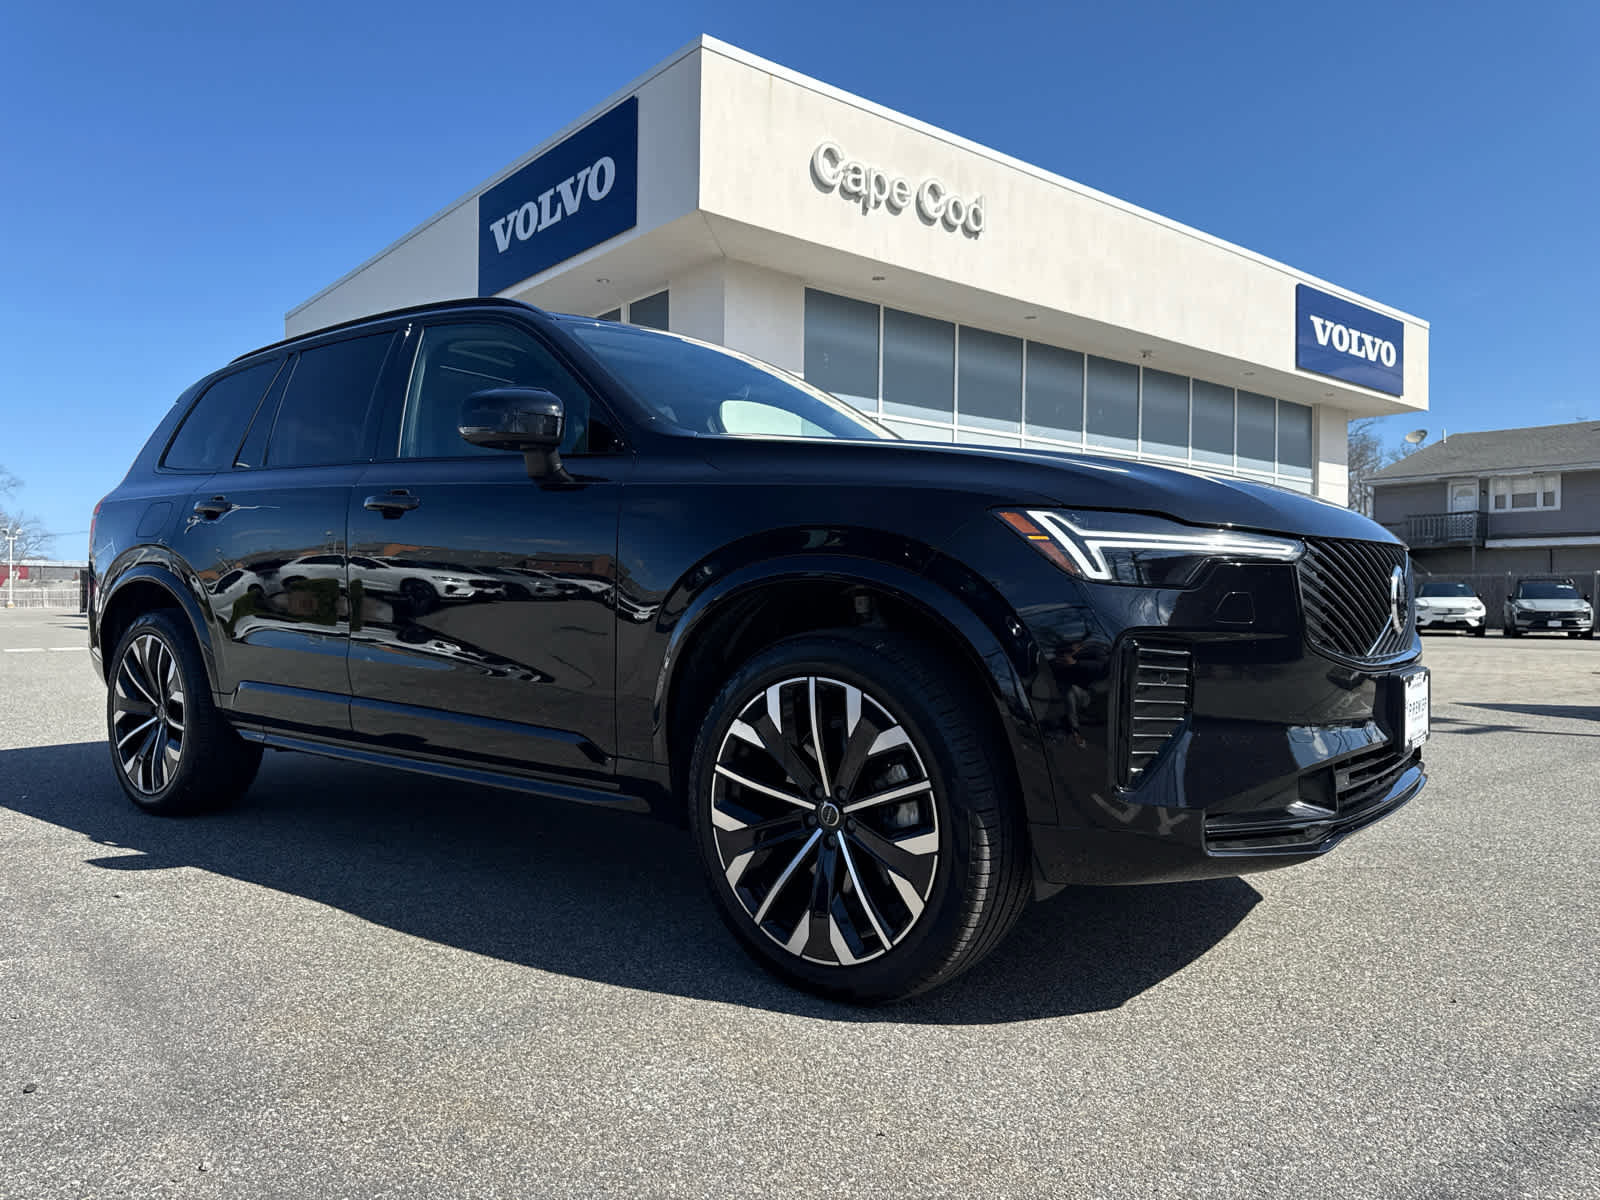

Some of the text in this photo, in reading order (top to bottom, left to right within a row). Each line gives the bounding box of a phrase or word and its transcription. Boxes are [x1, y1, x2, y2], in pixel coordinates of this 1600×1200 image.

[489, 156, 616, 254] VOLVO
[810, 142, 985, 238] Cape Cod
[1310, 314, 1397, 368] VOLVO
